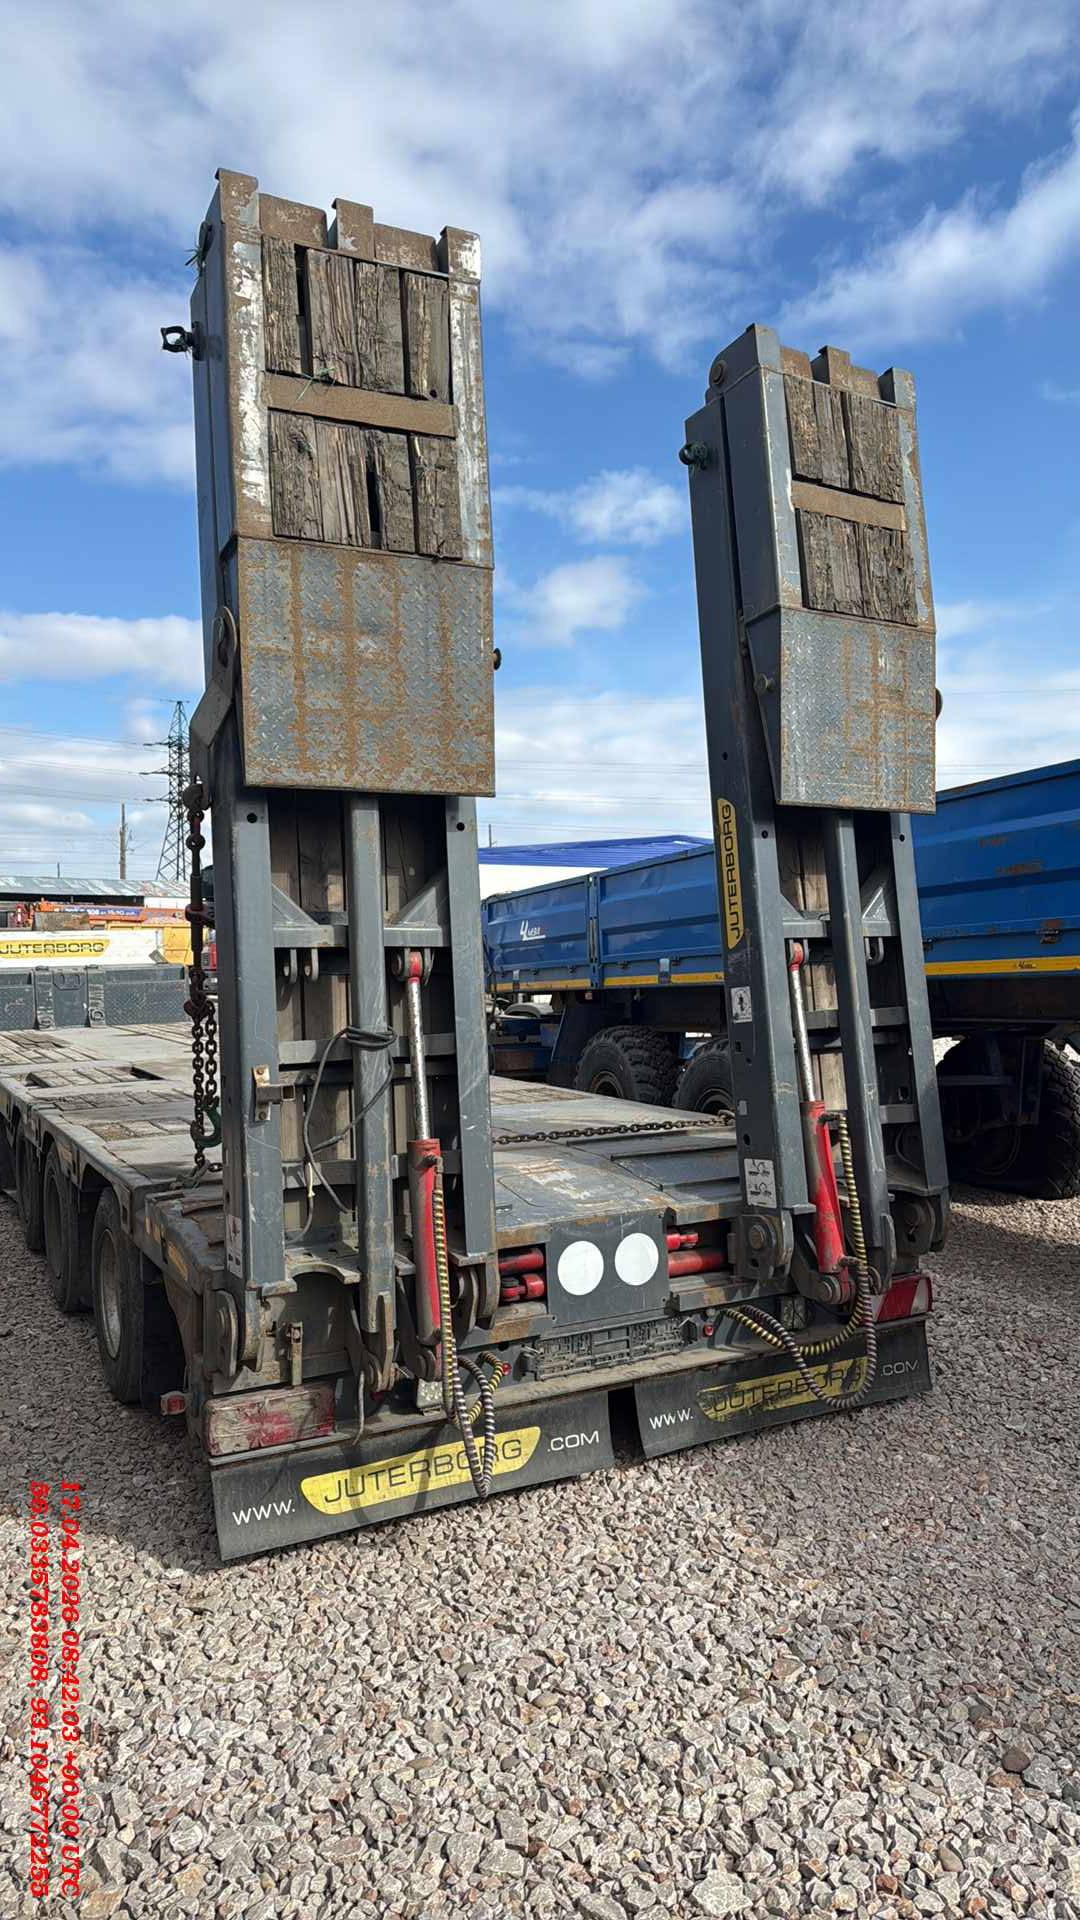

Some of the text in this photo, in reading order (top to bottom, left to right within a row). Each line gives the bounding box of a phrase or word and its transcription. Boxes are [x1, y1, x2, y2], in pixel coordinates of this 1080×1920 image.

[720, 802, 741, 941] JUTERBORG
[0, 942, 105, 955] JUTERBORG
[546, 1429, 601, 1454] .COM
